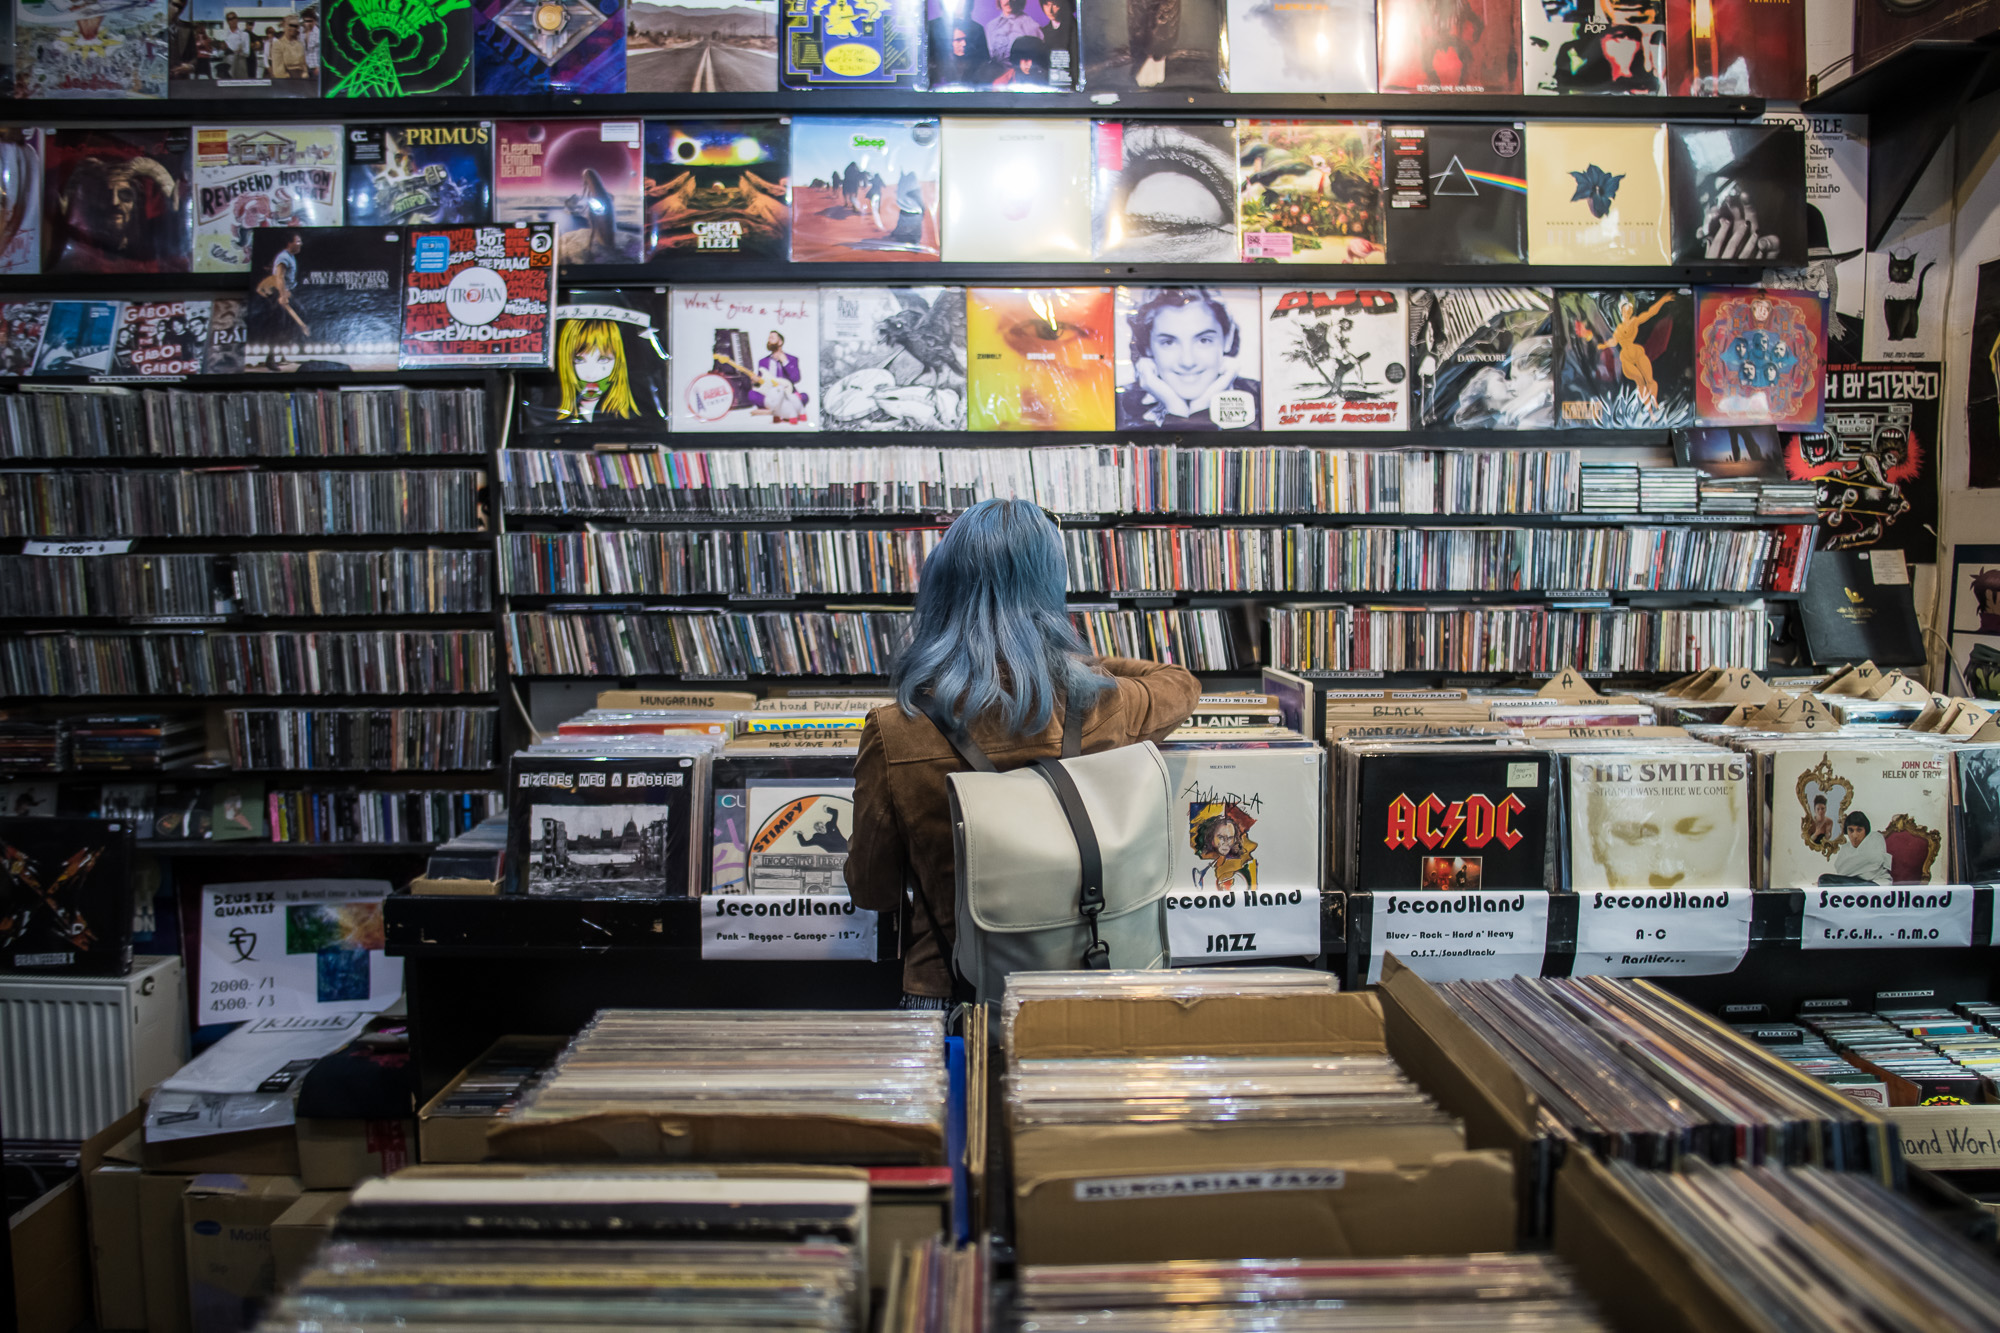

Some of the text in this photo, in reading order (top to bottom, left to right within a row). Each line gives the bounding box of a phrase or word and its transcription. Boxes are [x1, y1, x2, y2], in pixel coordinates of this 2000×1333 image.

[1584, 24, 1606, 33] POP
[406, 127, 488, 146] PRIMUS
[201, 174, 273, 215] REVEREND
[692, 221, 742, 237] GRETA
[698, 235, 741, 249] FLEET
[125, 302, 185, 322] GABOR
[727, 300, 754, 322] give
[413, 321, 529, 341] GREYHOUND
[131, 345, 181, 363] GABOR
[1457, 353, 1506, 363] DAWNCORE
[140, 358, 199, 375] GABORS
[1867, 371, 1939, 399] STEREO
[1857, 668, 1873, 679] W
[1562, 673, 1573, 690] A
[1740, 674, 1750, 689] G
[1903, 680, 1913, 695] S
[640, 696, 715, 708] HUNGARIANS
[779, 700, 809, 711] hand
[1373, 706, 1425, 718] BLACK
[1743, 707, 1753, 720] F
[1968, 712, 1980, 726] P
[1197, 715, 1250, 728] LAINE
[1805, 715, 1815, 729] C
[783, 730, 843, 740] REGGAE
[1569, 728, 1635, 738] RARITIES
[794, 740, 824, 748] WAVE
[1901, 761, 1922, 770] JOHN
[579, 772, 606, 787] MEG
[612, 772, 622, 787] A
[1580, 763, 1745, 783] THE SMITHS
[1882, 770, 1907, 779] HELEN
[1909, 770, 1919, 779] OF
[1181, 780, 1264, 815] AMANDLA
[1661, 786, 1687, 796] HERE
[1688, 786, 1702, 796] WE
[753, 801, 804, 853] STIMPY
[763, 857, 815, 866] INCOGNITO
[213, 892, 253, 906] DEUS
[1166, 889, 1303, 910] econd Hand
[214, 903, 276, 918] QUARTET
[716, 931, 739, 941] Punk
[748, 931, 784, 943] Reggae
[793, 931, 828, 942] Garage
[1386, 930, 1411, 940] Blues
[1419, 930, 1443, 940] Rock
[1452, 929, 1473, 940] Hard
[1487, 929, 1515, 940] Heavy
[1635, 929, 1645, 940] A
[1655, 928, 1667, 940] C
[1206, 932, 1257, 953] JAZZ
[1878, 990, 1933, 998] CARIBBEAN
